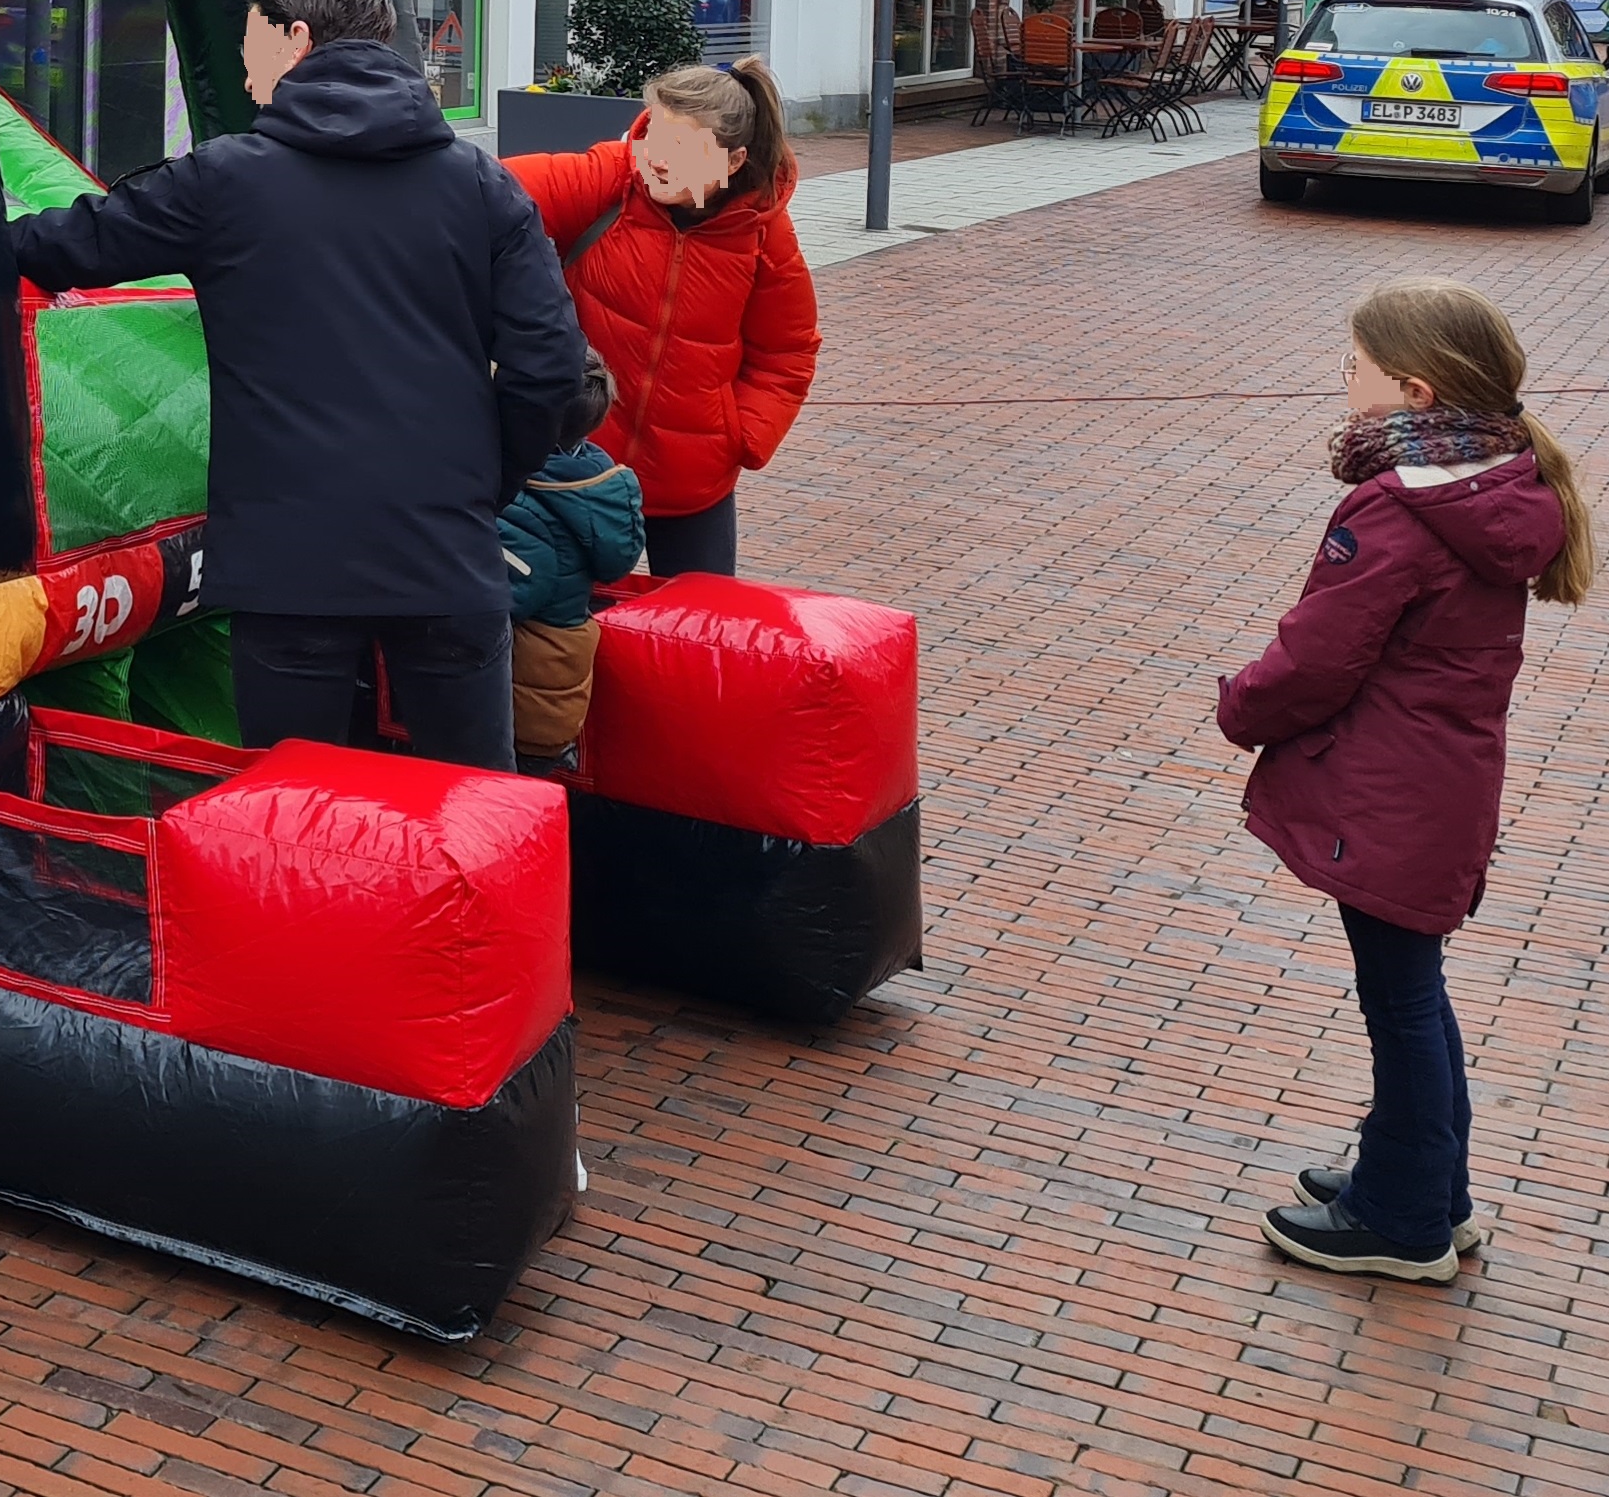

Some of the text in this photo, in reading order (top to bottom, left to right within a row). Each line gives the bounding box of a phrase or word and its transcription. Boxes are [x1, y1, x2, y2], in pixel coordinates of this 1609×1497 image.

[1486, 7, 1517, 18] 10/24
[1331, 83, 1368, 93] POLIZEI
[1372, 104, 1393, 118] EL
[1416, 106, 1457, 122] 3483
[60, 574, 134, 655] 30
